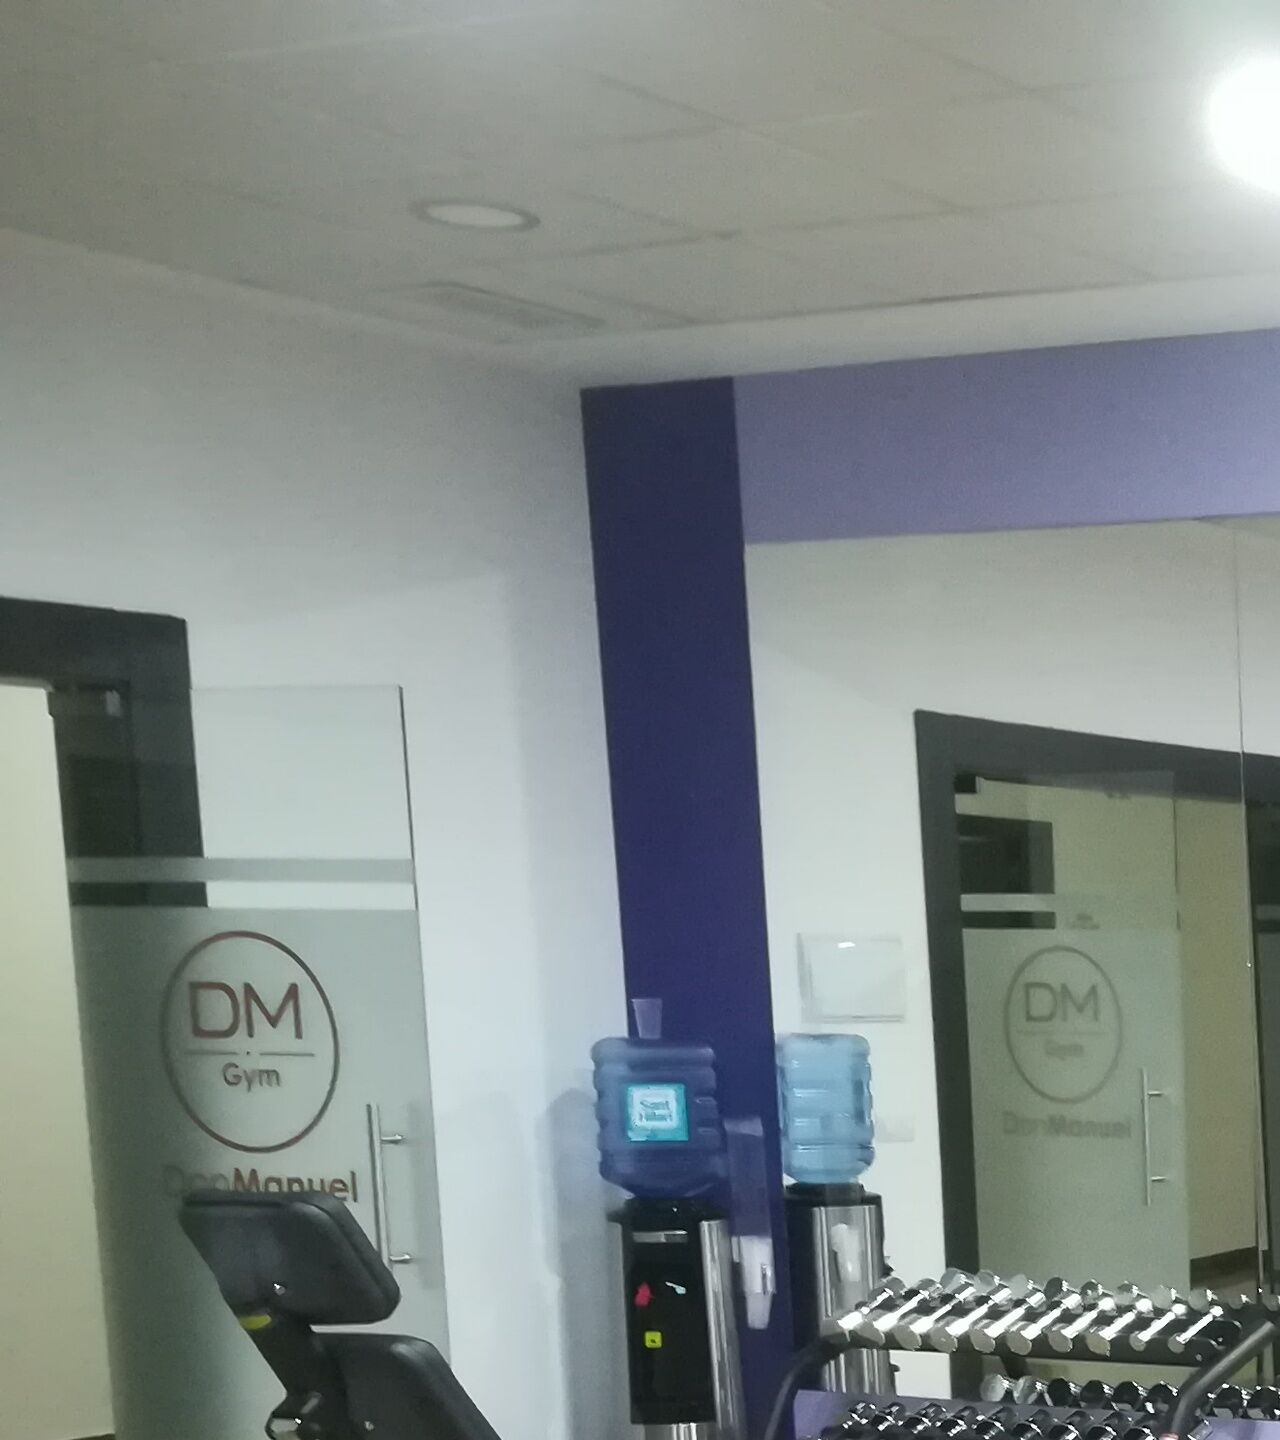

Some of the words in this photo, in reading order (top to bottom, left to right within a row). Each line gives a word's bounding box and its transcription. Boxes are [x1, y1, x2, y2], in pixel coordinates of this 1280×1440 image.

[188, 981, 303, 1040] DM
[1025, 982, 1099, 1022] DM
[221, 1062, 282, 1093] Gym
